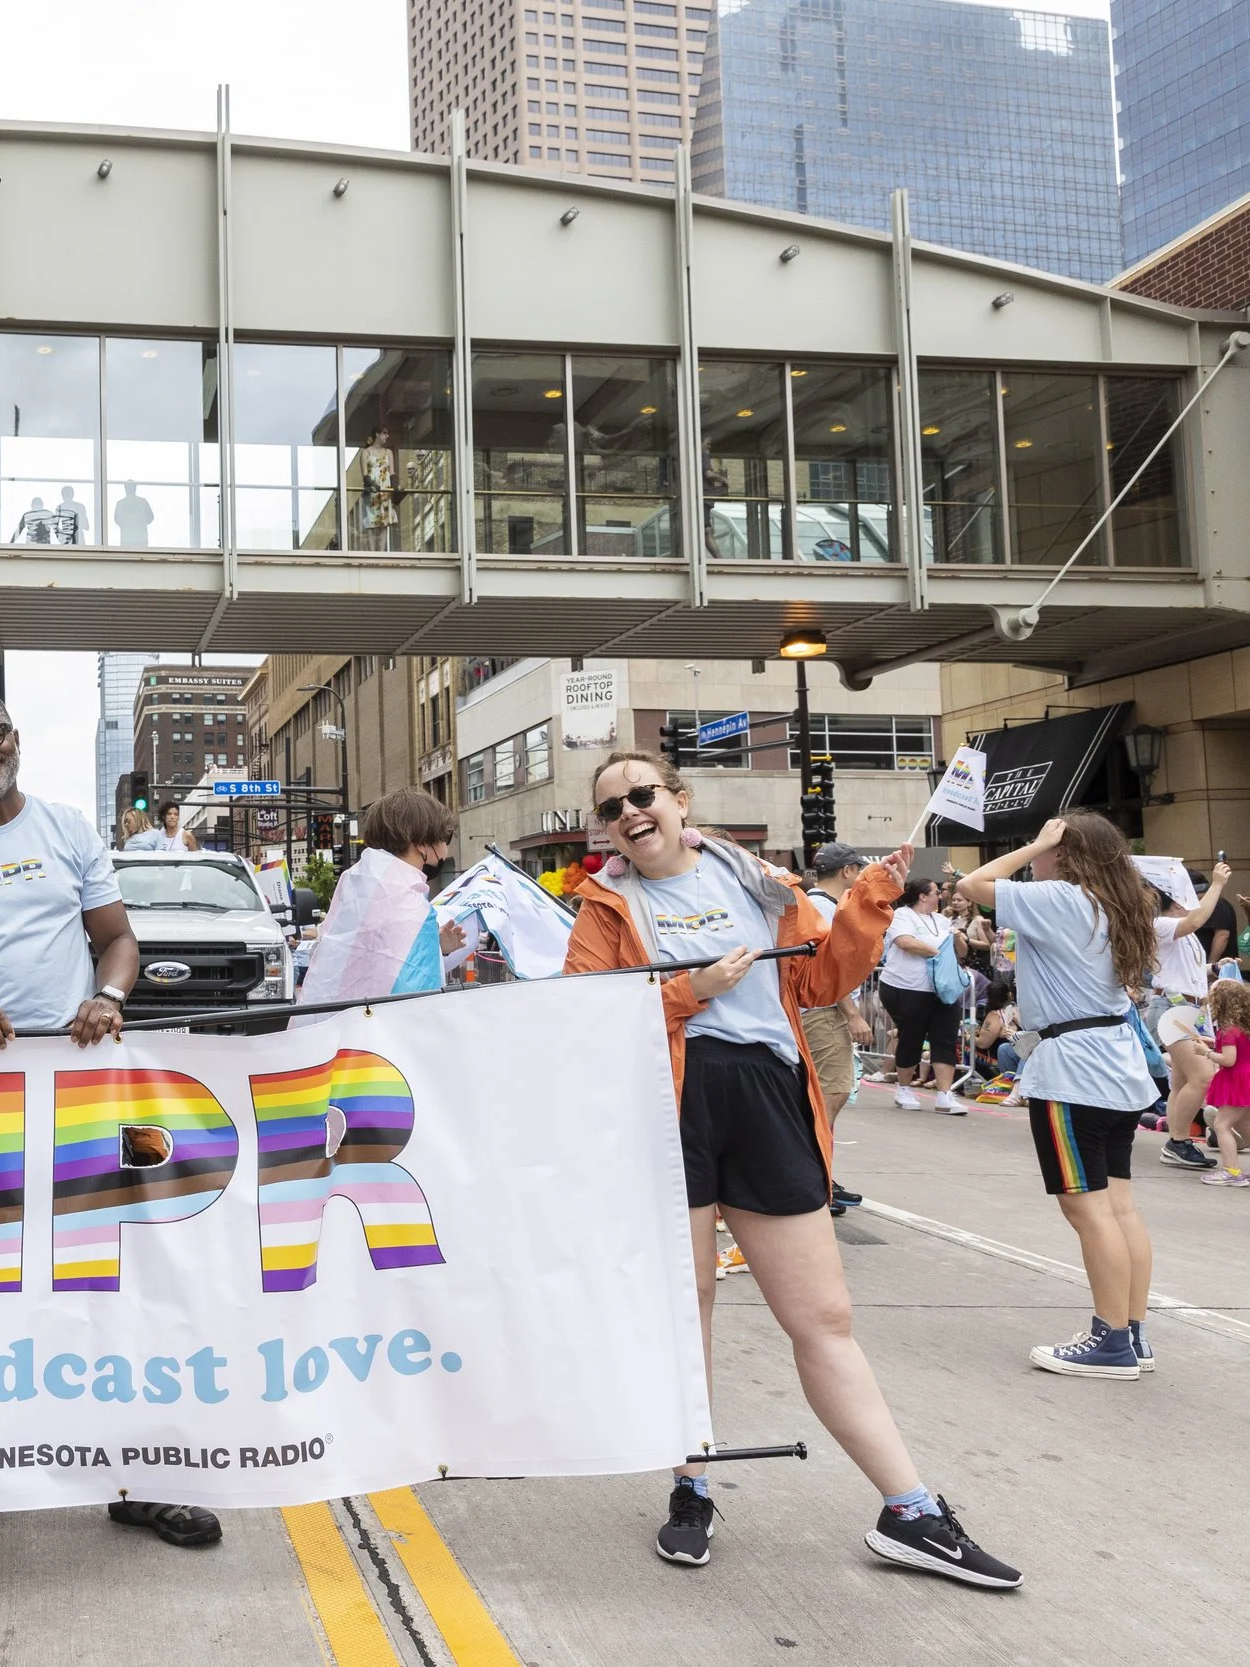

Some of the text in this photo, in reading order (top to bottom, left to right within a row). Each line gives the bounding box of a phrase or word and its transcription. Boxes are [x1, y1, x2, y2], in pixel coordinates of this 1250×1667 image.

[168, 677, 242, 686] EMBASSY SUITES
[566, 673, 613, 683] YEAR-ROUND
[566, 681, 613, 693] ROOFTOP
[566, 690, 613, 704] DINING
[706, 717, 747, 738] Hennepin Av
[1006, 768, 1035, 781] THE
[229, 783, 278, 793] S 8th St
[984, 779, 1038, 800] CAPITAL
[257, 811, 278, 821] Loft
[655, 908, 734, 935] MPR
[157, 966, 179, 977] Ford
[257, 1327, 464, 1402] love.
[121, 1444, 232, 1471] PUBLIC
